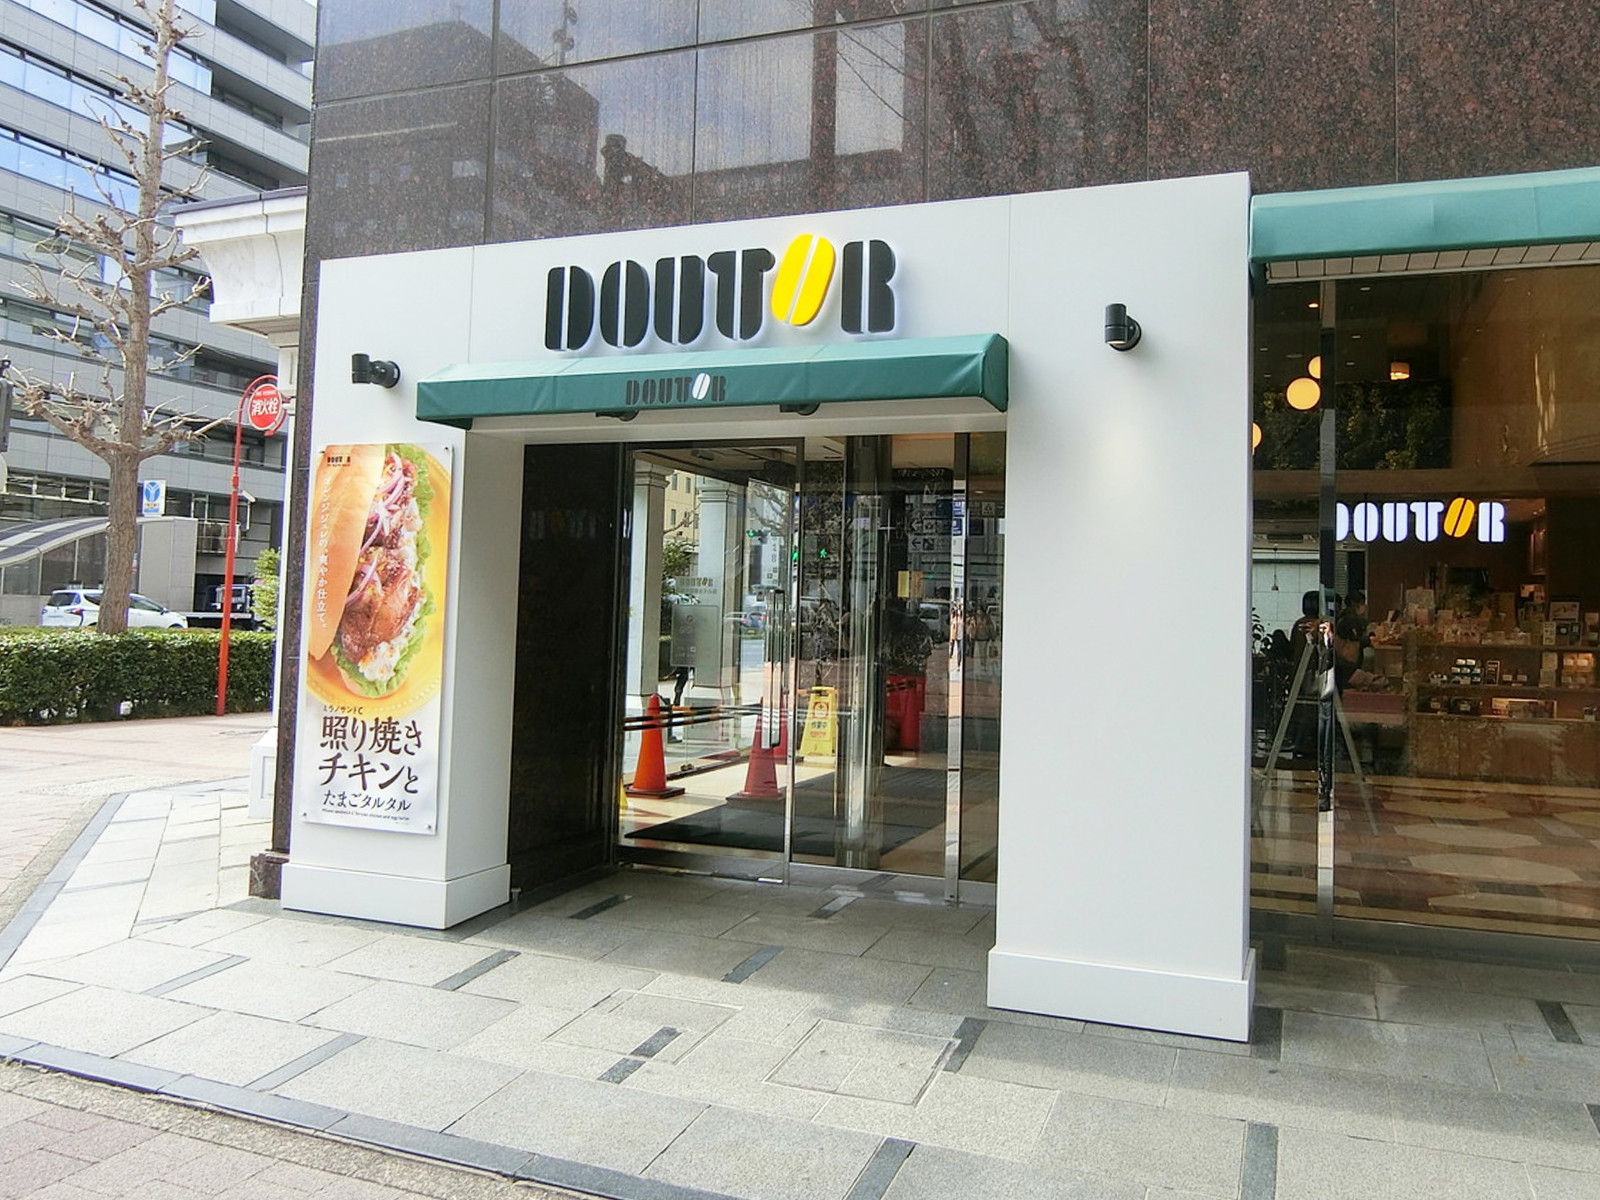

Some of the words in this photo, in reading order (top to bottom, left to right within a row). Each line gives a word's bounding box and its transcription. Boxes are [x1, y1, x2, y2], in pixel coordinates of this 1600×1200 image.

[545, 233, 897, 352] DOUTOR
[251, 397, 278, 416] 消火栓
[625, 373, 727, 405] DOUTOR
[320, 716, 422, 756] 照り焼き
[318, 752, 418, 794] チキンと
[323, 789, 411, 812] たまごタルタル
